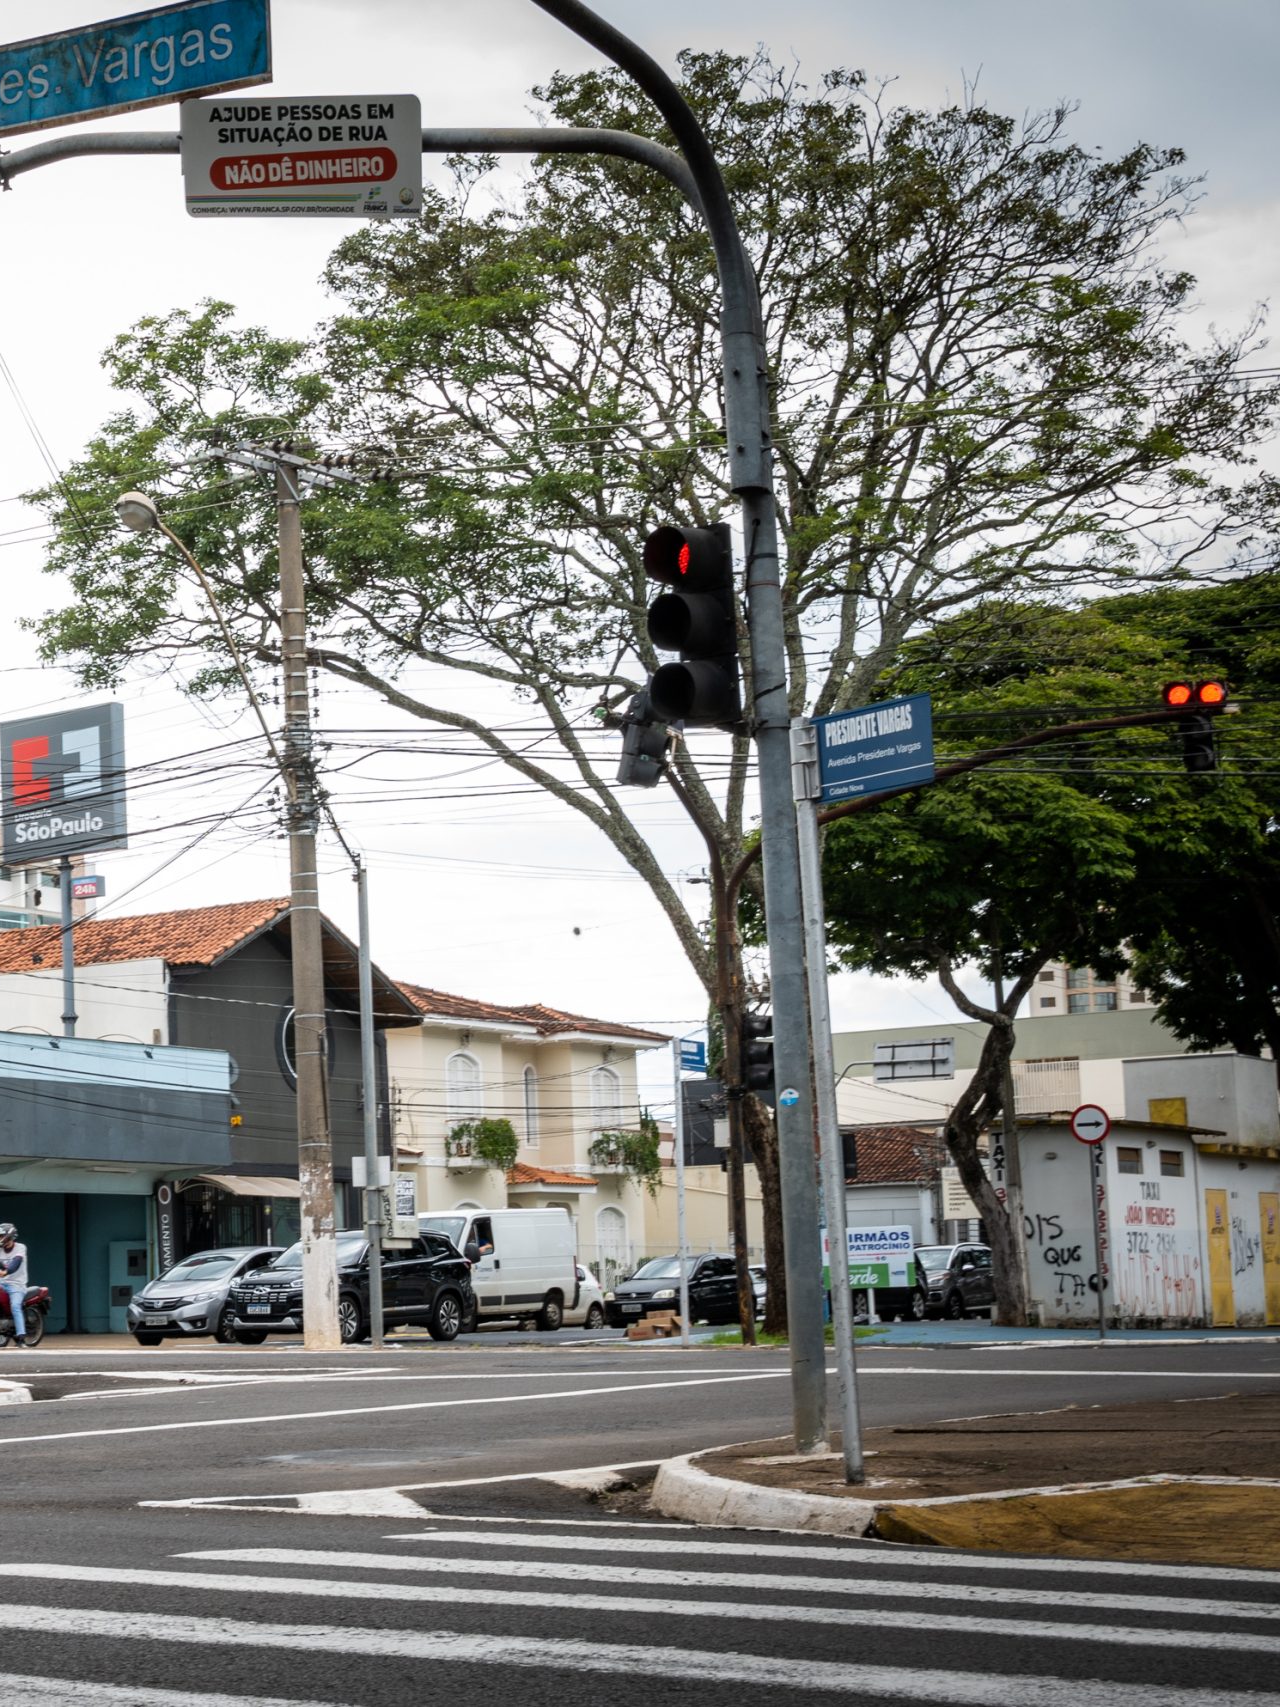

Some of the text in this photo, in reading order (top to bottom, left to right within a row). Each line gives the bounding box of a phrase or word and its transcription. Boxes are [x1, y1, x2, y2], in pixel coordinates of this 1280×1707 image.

[73, 22, 234, 89] Vargas
[209, 103, 395, 123] AJUDE PESSOAS EM
[218, 122, 388, 147] SITUAÇÃO DE RUA
[224, 156, 385, 185] NÃO DÊ DINHEIRO
[825, 704, 913, 748] PRESIDENTE VARGAS
[827, 741, 922, 769] Avenida Presidente Vargas
[75, 884, 97, 895] 24h
[990, 1132, 1006, 1182] TAXI
[1139, 1181, 1161, 1201] TAXI
[1145, 1206, 1176, 1226] MENDES
[848, 1230, 911, 1242] IRMÃOS
[848, 1242, 911, 1251] PATROCÍNIO
